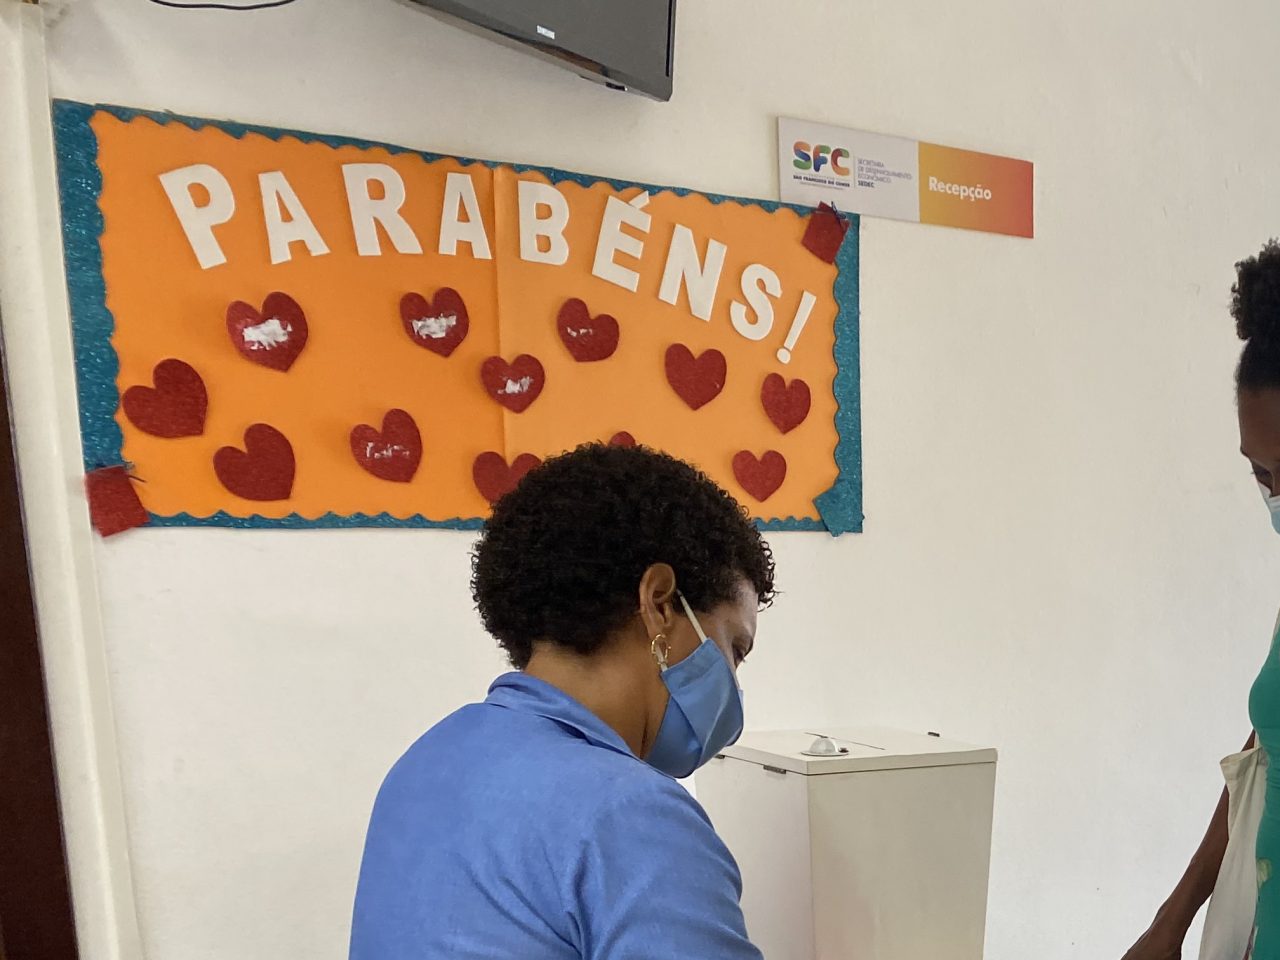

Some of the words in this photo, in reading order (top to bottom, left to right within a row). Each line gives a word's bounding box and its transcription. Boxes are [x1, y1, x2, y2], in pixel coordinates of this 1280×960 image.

[793, 141, 850, 176] SFC
[928, 176, 992, 202] Recepção
[157, 162, 816, 364] PARABÉNS!
